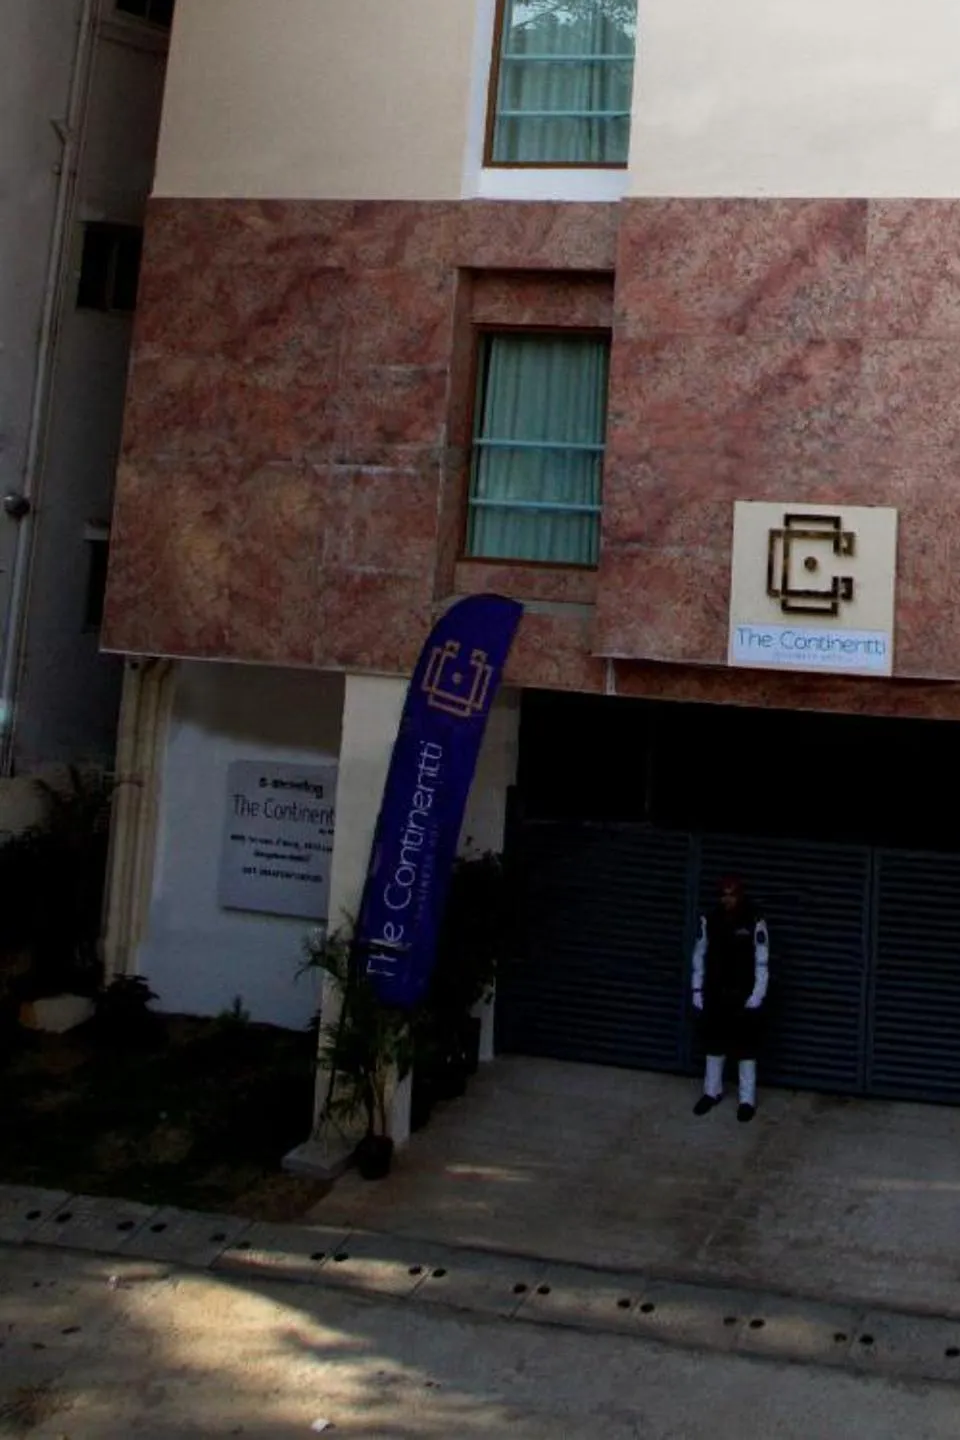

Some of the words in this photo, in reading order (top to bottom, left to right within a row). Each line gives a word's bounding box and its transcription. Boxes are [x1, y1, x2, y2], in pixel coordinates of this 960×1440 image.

[737, 627, 774, 648] The
[231, 793, 260, 817] The
[384, 740, 443, 909] Continentti
